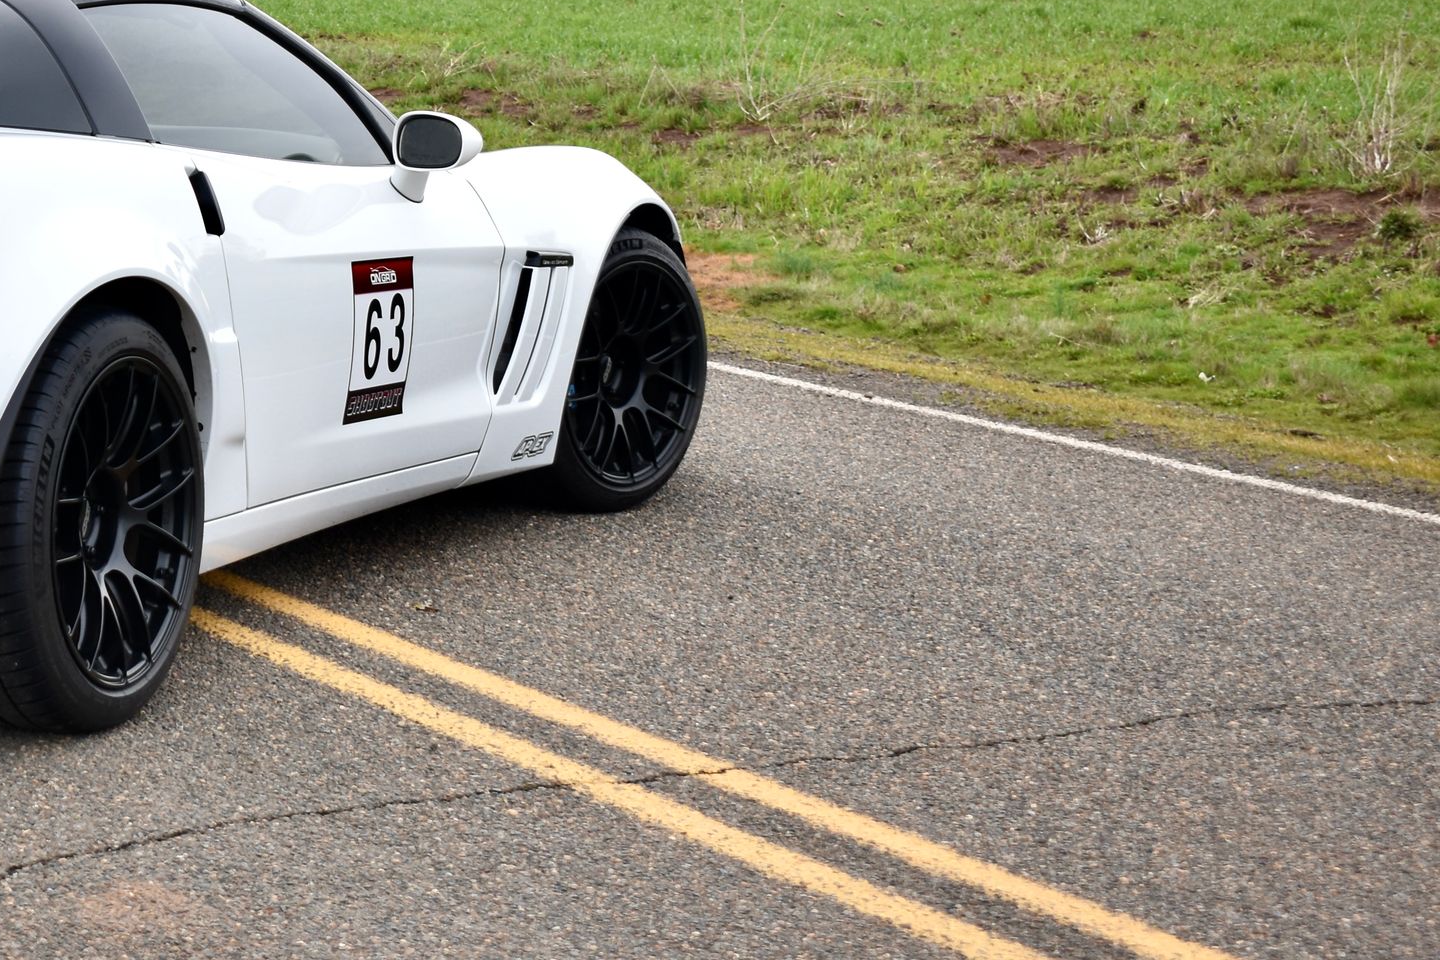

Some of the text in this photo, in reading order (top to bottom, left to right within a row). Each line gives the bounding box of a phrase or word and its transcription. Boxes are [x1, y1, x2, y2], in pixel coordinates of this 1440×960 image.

[363, 292, 406, 380] 63
[347, 387, 403, 416] SHOOTOUT
[33, 435, 56, 567] MICHELIN
